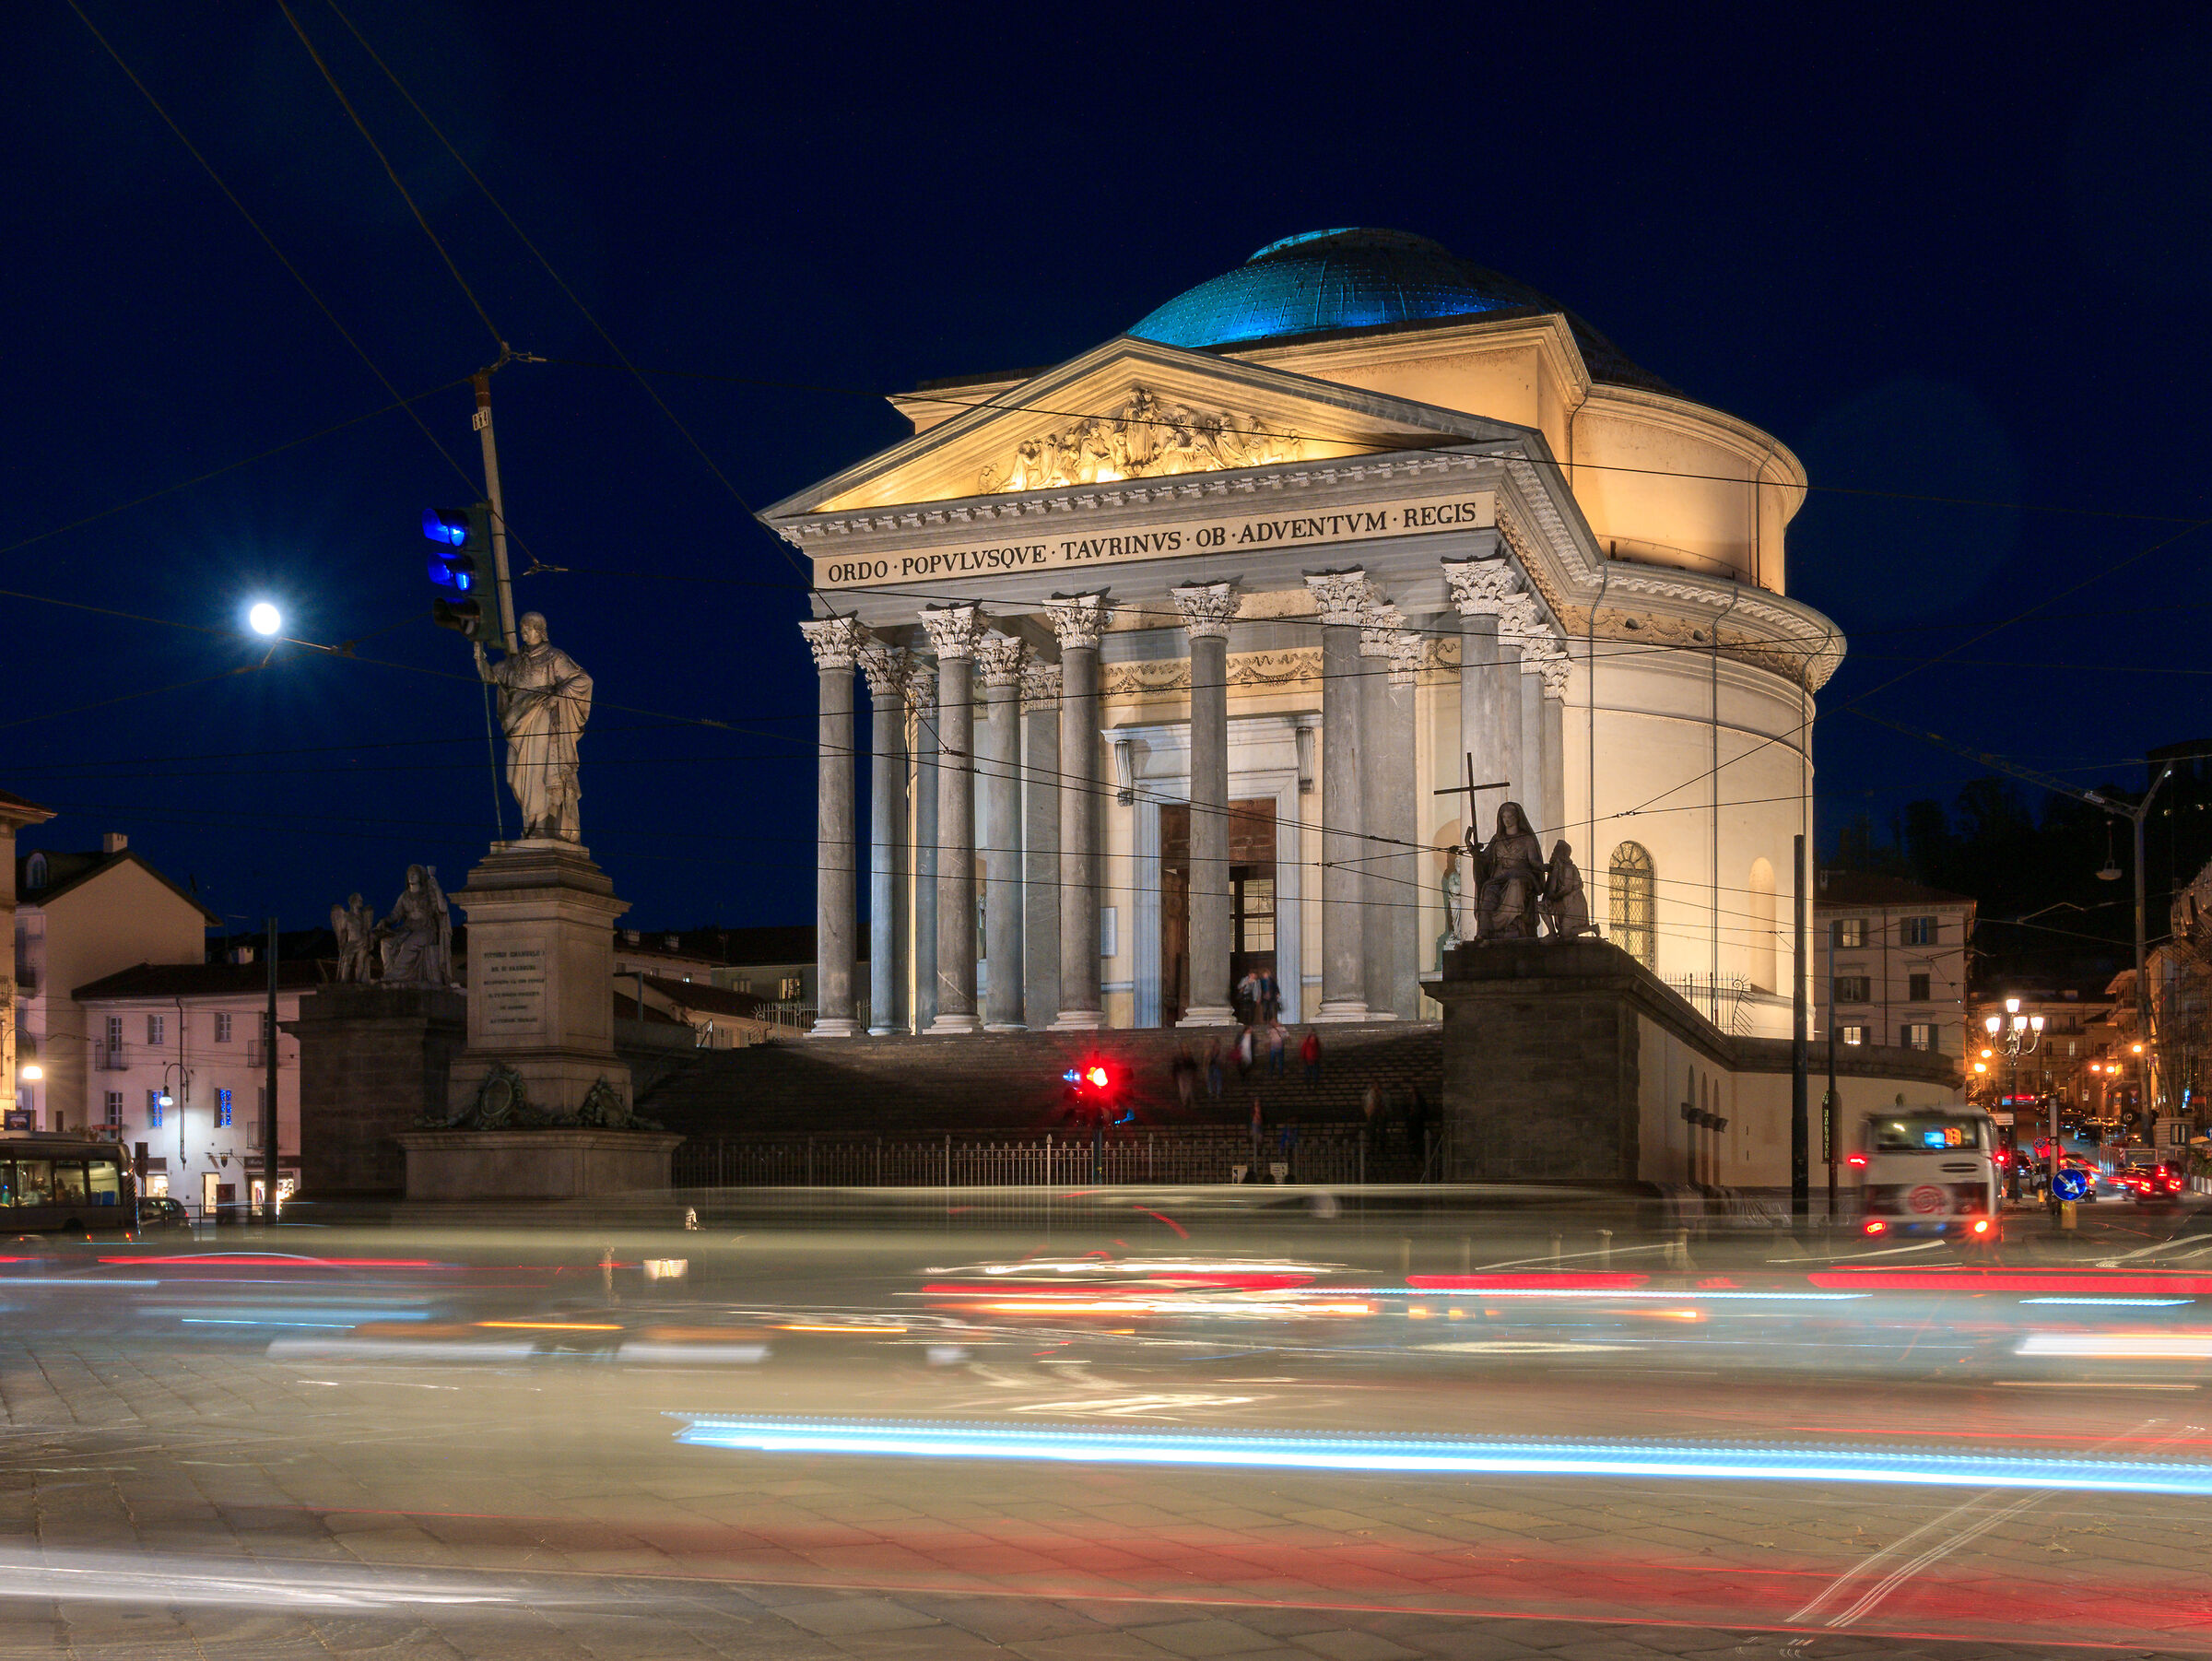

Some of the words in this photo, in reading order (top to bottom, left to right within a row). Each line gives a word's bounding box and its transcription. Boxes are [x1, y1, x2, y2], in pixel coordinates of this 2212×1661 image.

[829, 560, 888, 583] ORDO
[901, 545, 1046, 576] POPVLVSQVE
[1061, 531, 1181, 560] TAVRINVS
[1196, 528, 1225, 547] OB
[1238, 511, 1387, 544] ADVENTVM
[1403, 502, 1477, 528] REGIS
